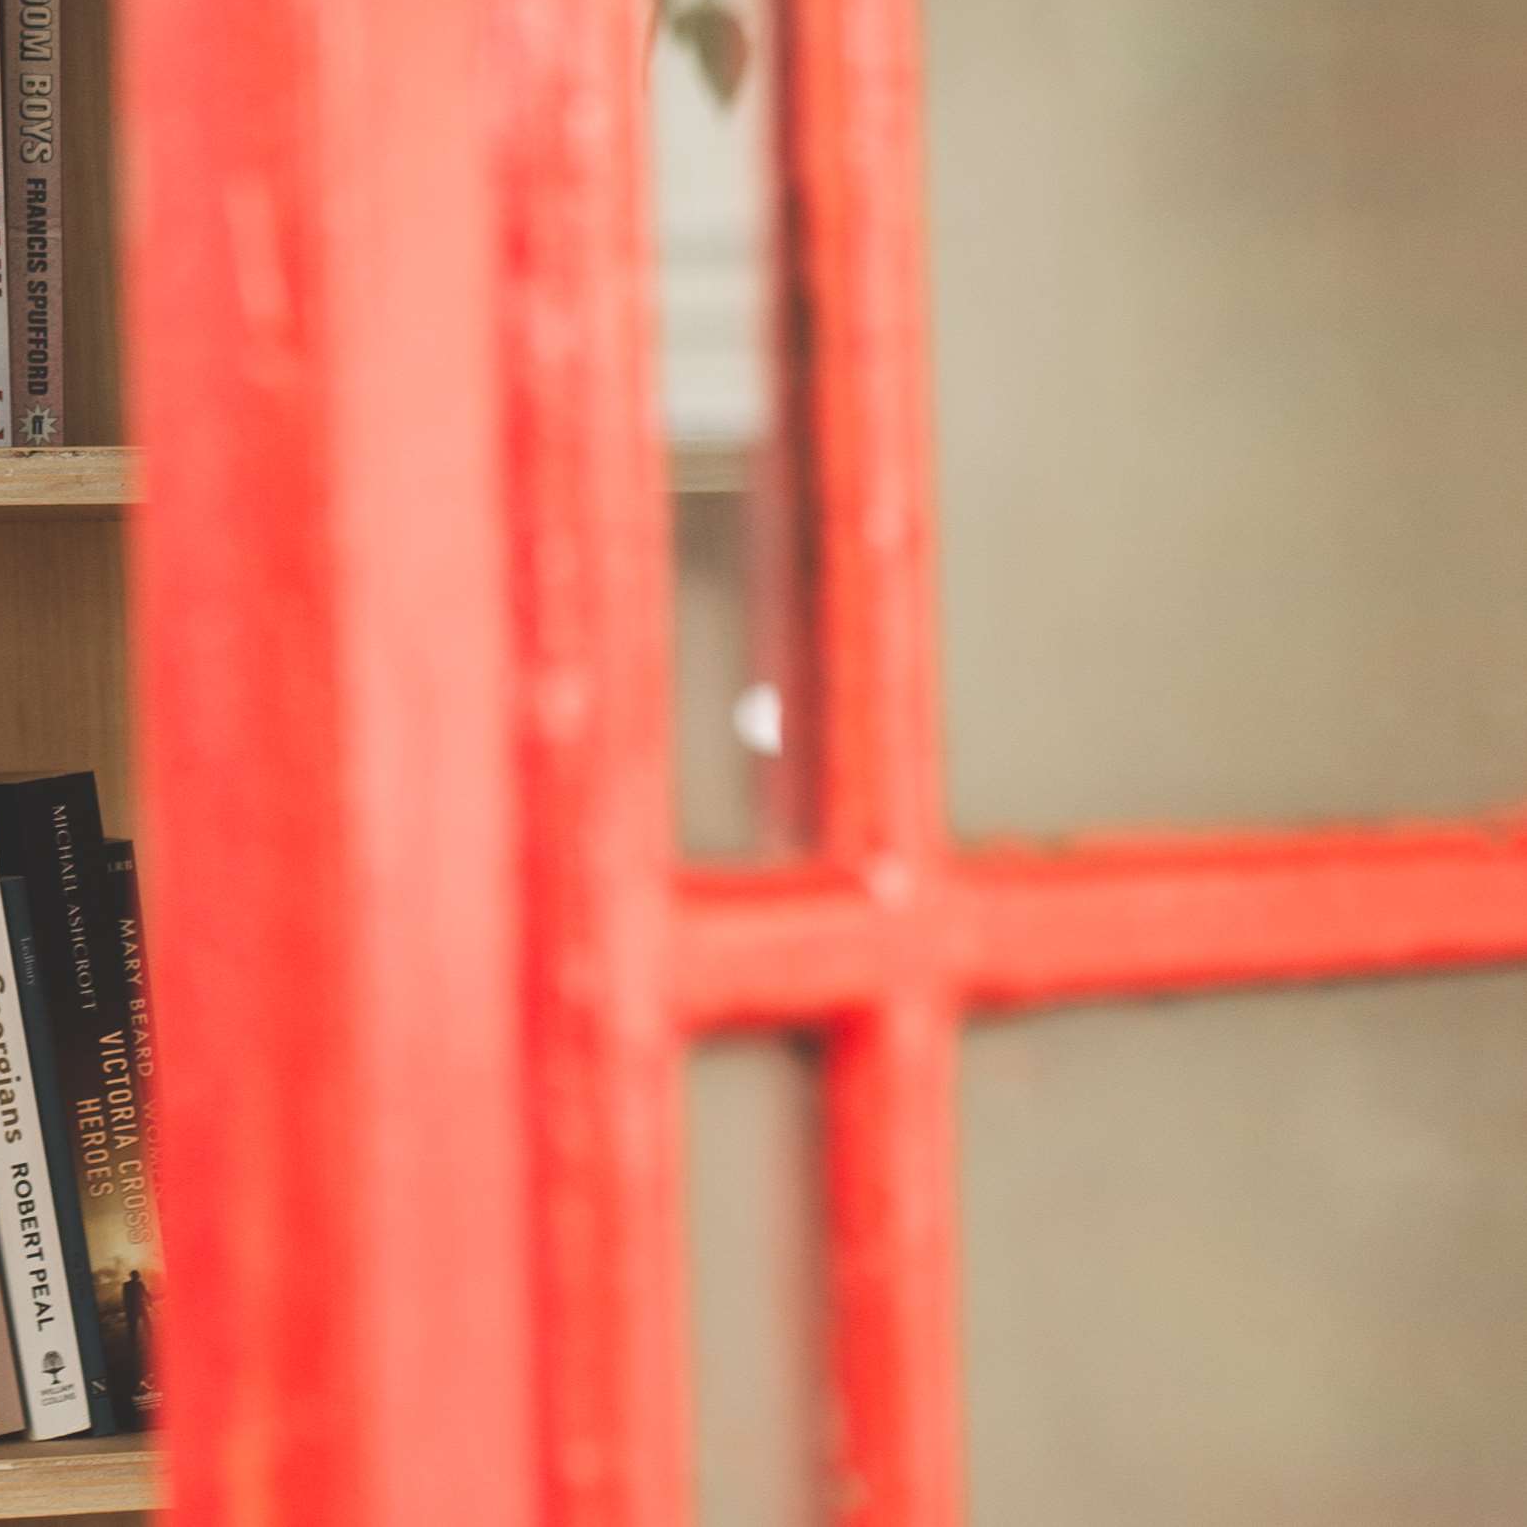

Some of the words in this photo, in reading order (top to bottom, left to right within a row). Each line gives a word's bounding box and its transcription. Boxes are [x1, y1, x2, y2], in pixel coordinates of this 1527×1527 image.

[19, 75, 53, 164] BOYS
[26, 178, 48, 273] FRANCIS
[27, 280, 49, 396] SPUFFORD
[52, 803, 79, 896] MICHAEL
[67, 904, 98, 1010] ASHCROFT
[118, 918, 143, 986] MARY
[129, 999, 154, 1076] BEARD
[99, 1028, 138, 1149] VICTORIA
[75, 1098, 114, 1197] HEROES
[11, 1162, 45, 1262] ROBERT
[29, 1268, 55, 1332] PEAL
[118, 1160, 153, 1244] CROSS
